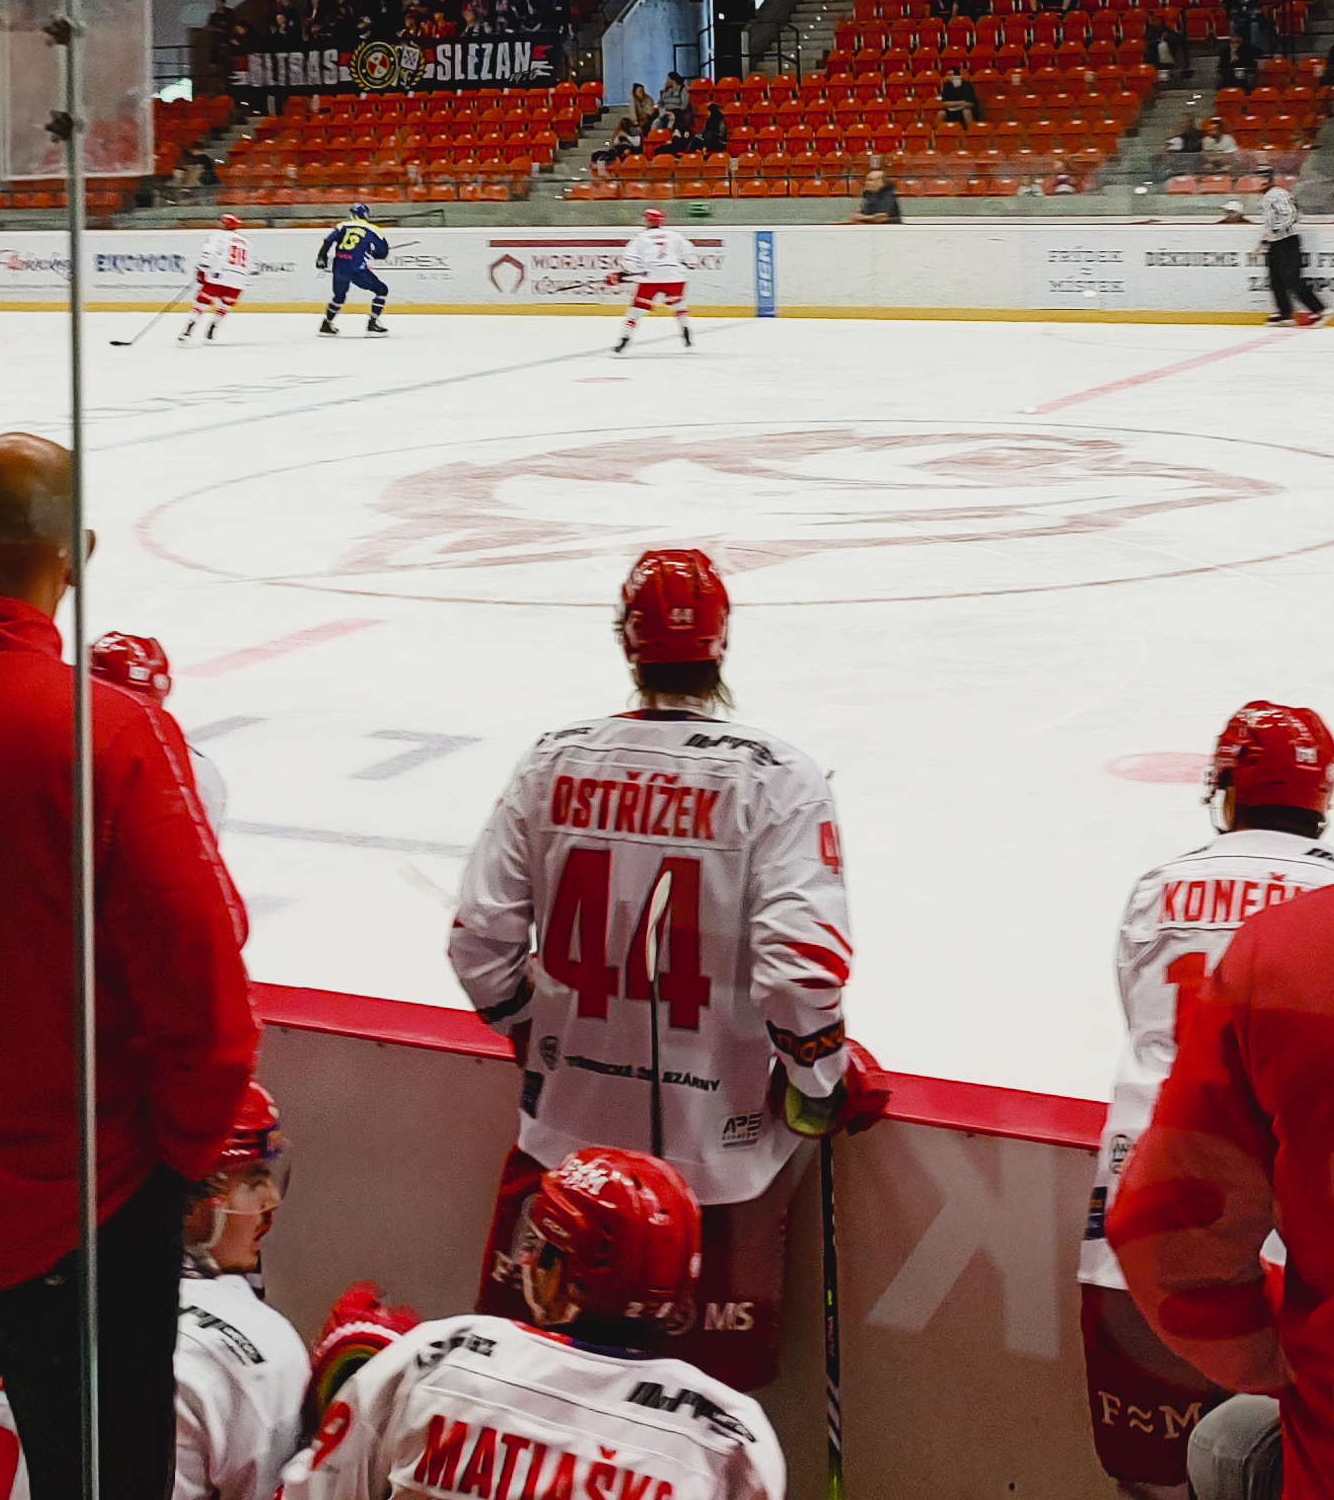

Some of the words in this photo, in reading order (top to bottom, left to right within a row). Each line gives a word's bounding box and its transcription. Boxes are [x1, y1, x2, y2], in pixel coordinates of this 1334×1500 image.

[436, 42, 531, 81] SLEZAN
[551, 771, 721, 841] OSTŘÍŽEK
[1160, 872, 1307, 923] KONEČ
[543, 846, 712, 1032] 44
